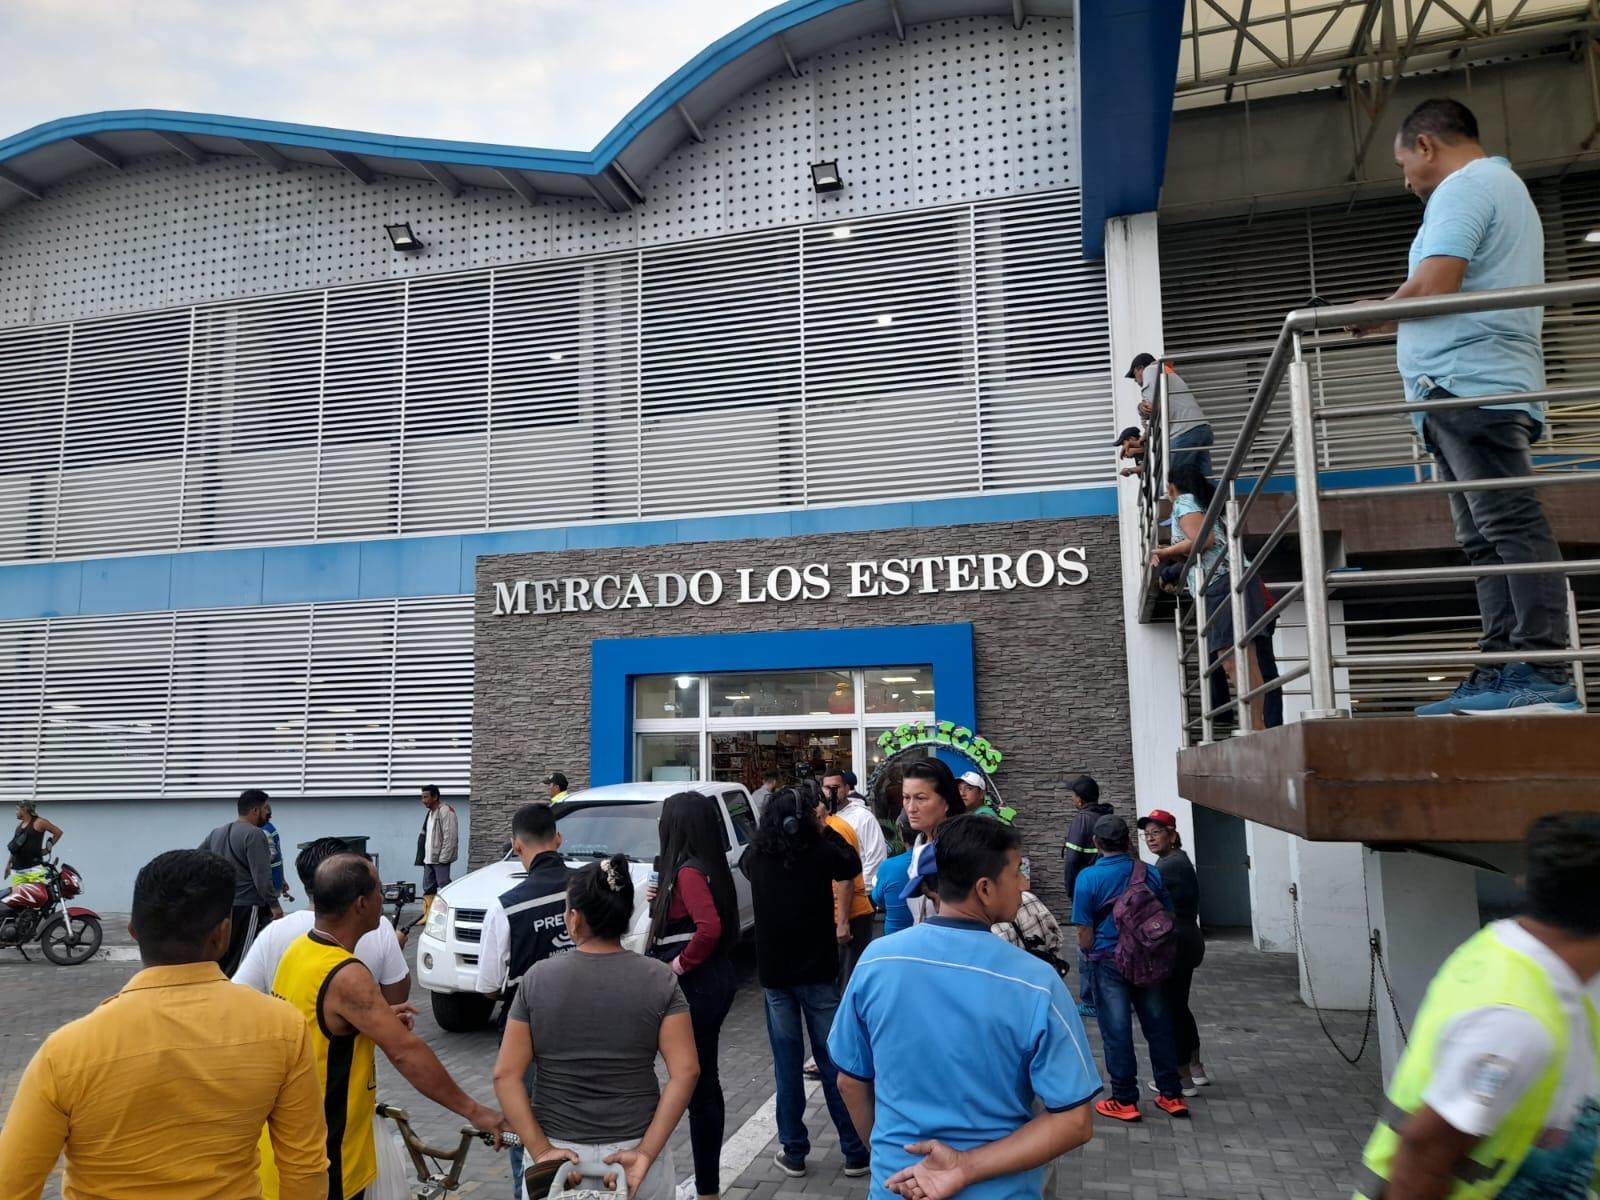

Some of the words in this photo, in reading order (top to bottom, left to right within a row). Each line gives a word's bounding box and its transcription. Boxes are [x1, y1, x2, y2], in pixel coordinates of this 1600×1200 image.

[492, 568, 723, 616] MERCADO
[736, 563, 831, 604] LOS
[846, 547, 1090, 598] ESTEROS
[533, 913, 566, 932] PRE
